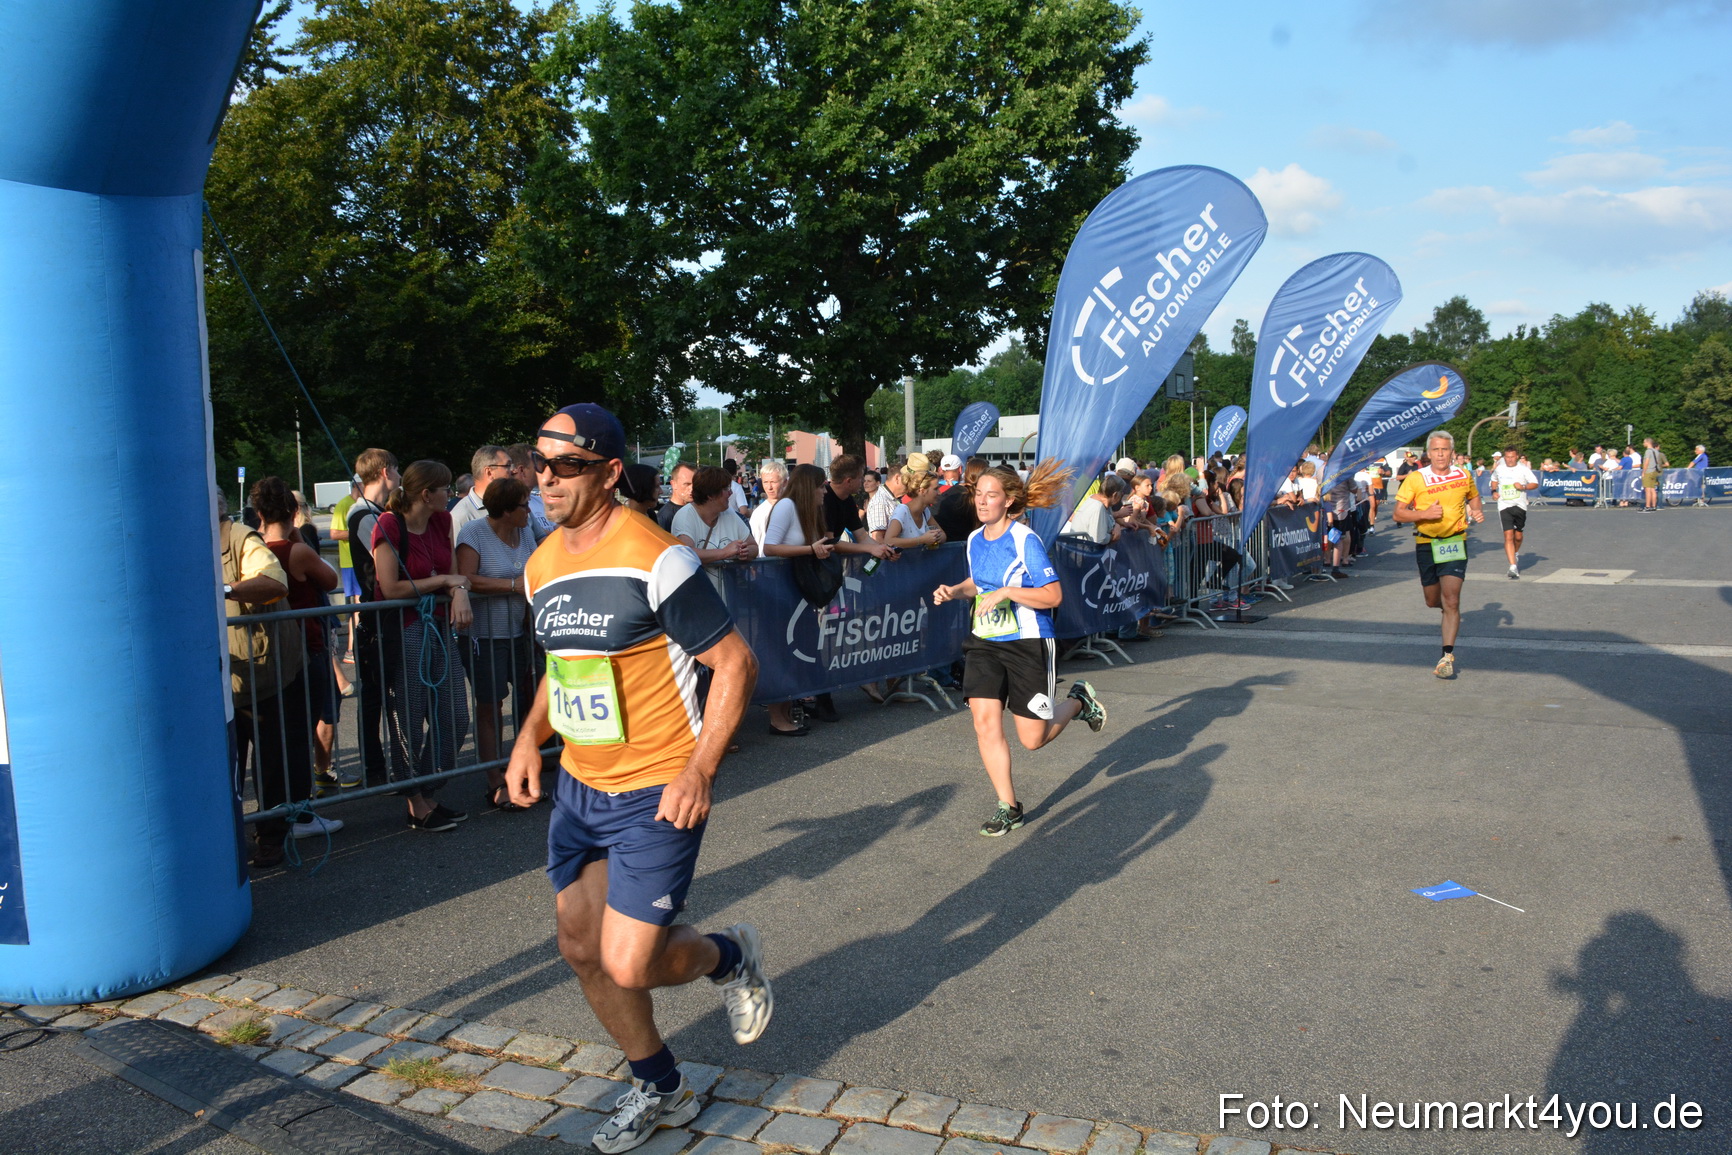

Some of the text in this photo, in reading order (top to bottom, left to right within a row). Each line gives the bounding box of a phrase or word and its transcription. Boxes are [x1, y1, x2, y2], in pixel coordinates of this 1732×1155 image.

[1100, 202, 1218, 359] Fischer
[1141, 232, 1232, 358] AUTOMOBILE
[1288, 276, 1368, 389] Fischer
[1317, 297, 1379, 387] AUTOMOBILE
[963, 409, 991, 446] Fischer
[1218, 411, 1239, 442] Fischer
[1344, 399, 1432, 453] Frischmann
[1400, 415, 1422, 431] Druck
[1435, 394, 1461, 413] Medien
[1427, 485, 1449, 495] MAX
[1542, 478, 1583, 487] Frischmann
[1271, 526, 1310, 549] Frischmann
[1439, 544, 1459, 555] 844
[544, 607, 615, 630] Fischer
[550, 627, 608, 638] AUTOMOBILE
[817, 603, 928, 650] Fischer
[828, 639, 920, 671] AUTOMOBILE
[553, 686, 610, 721] 1615
